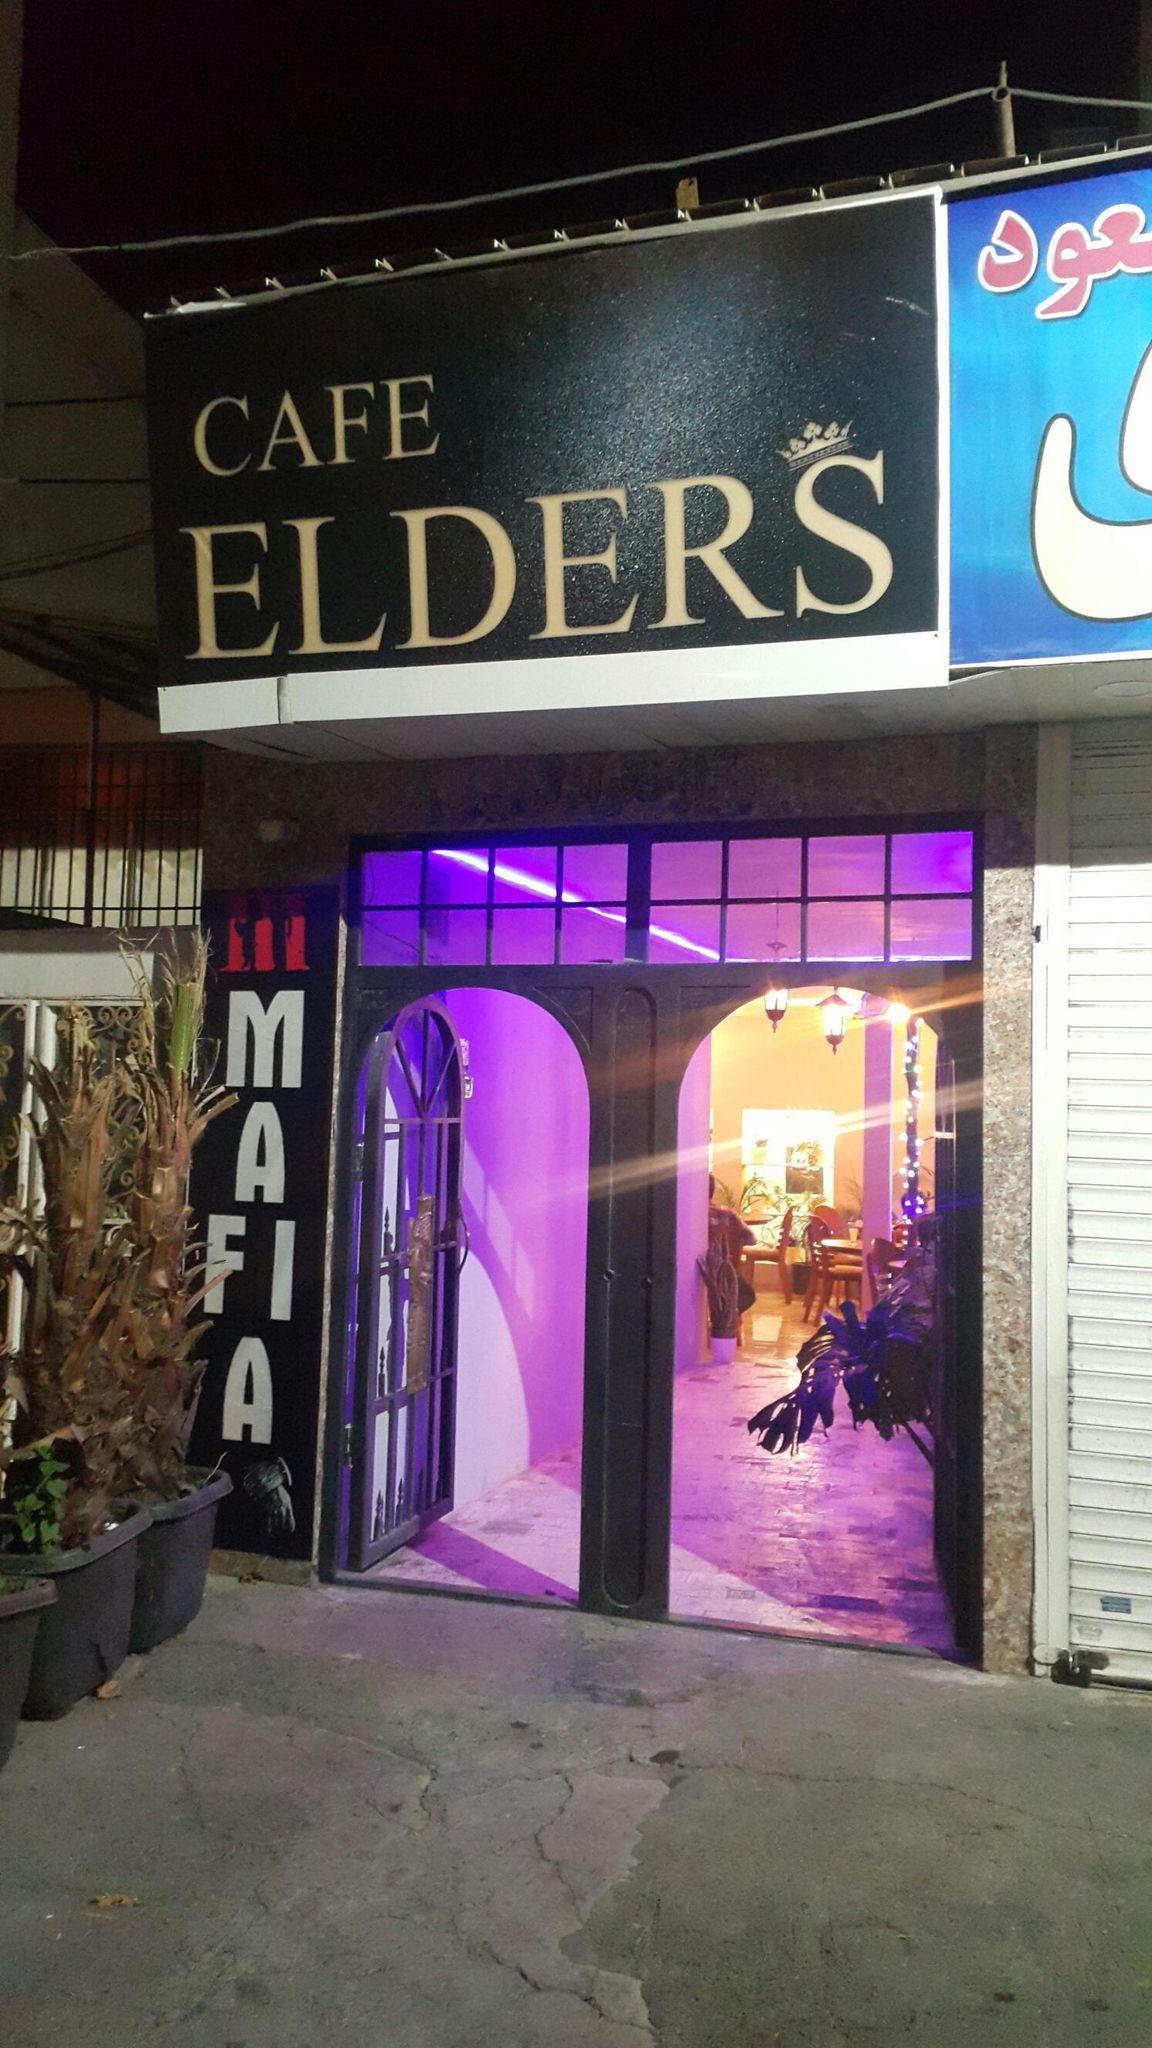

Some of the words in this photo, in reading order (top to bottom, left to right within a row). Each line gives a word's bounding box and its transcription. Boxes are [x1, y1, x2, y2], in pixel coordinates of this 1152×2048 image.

[977, 204, 1152, 320] عود
[193, 375, 441, 477] CAFE
[179, 450, 894, 660] ELDERS
